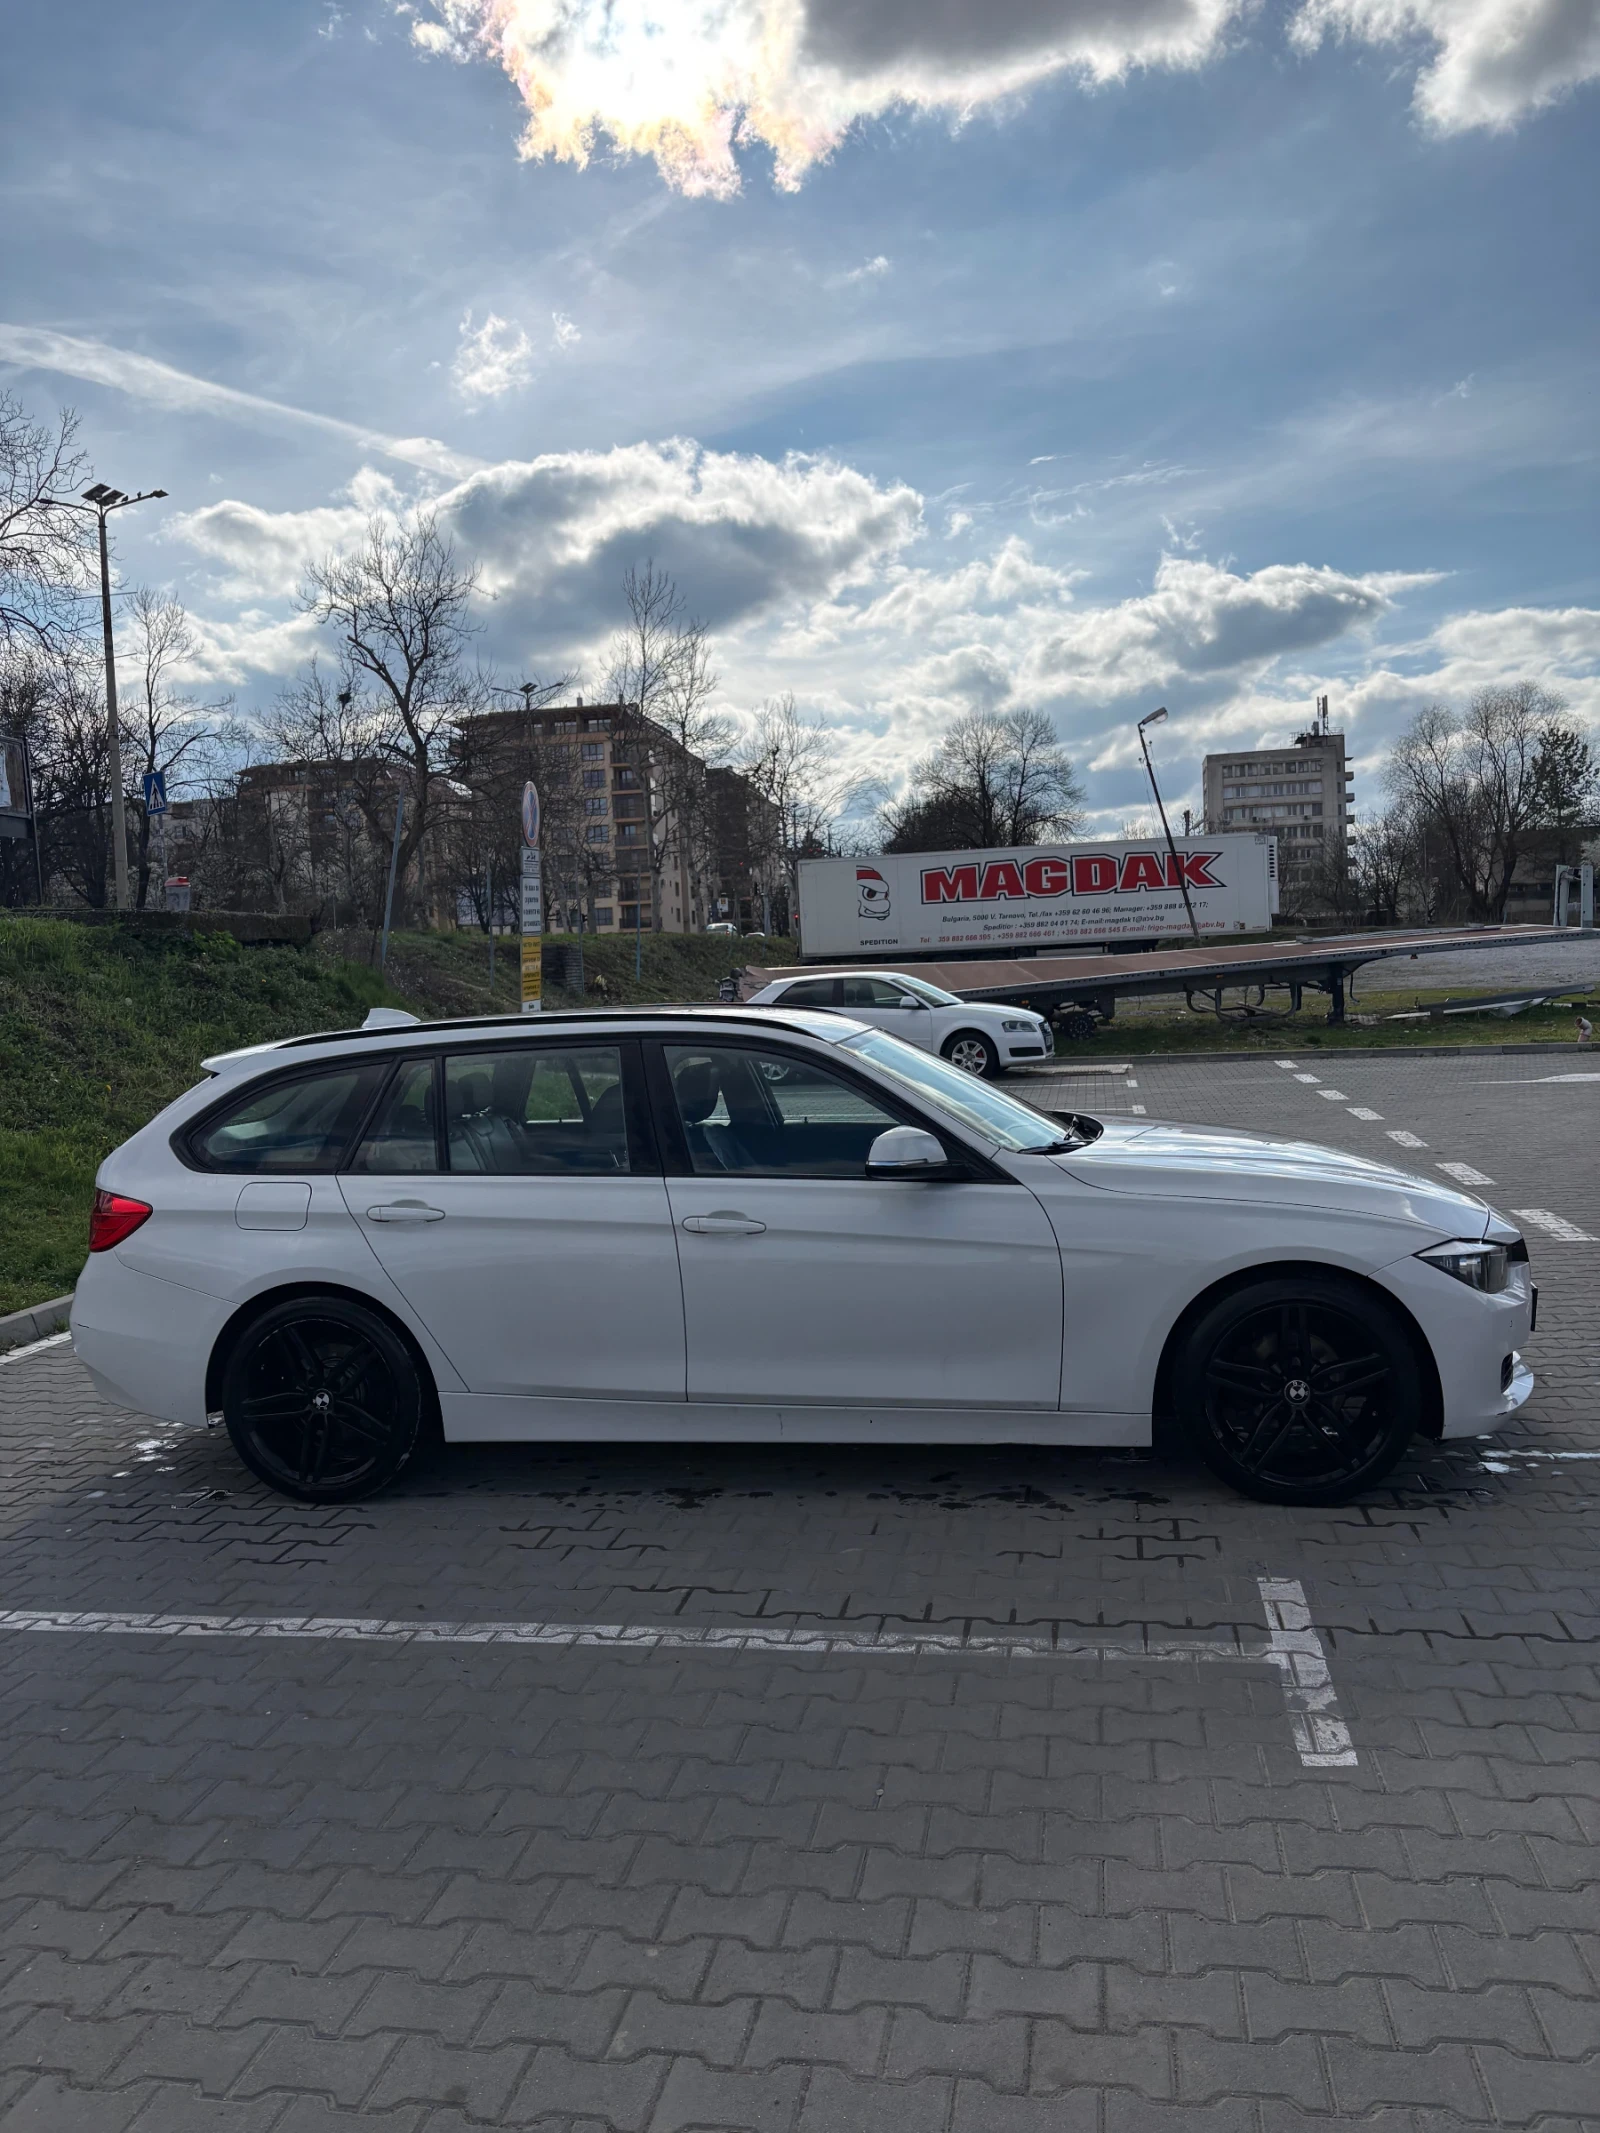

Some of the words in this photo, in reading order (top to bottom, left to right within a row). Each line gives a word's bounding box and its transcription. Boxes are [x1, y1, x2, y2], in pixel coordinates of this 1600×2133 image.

[920, 851, 1227, 904] MAGDAK
[1114, 905, 1145, 913] Manager:
[1148, 921, 1225, 931] frigo-magda@abv.bg
